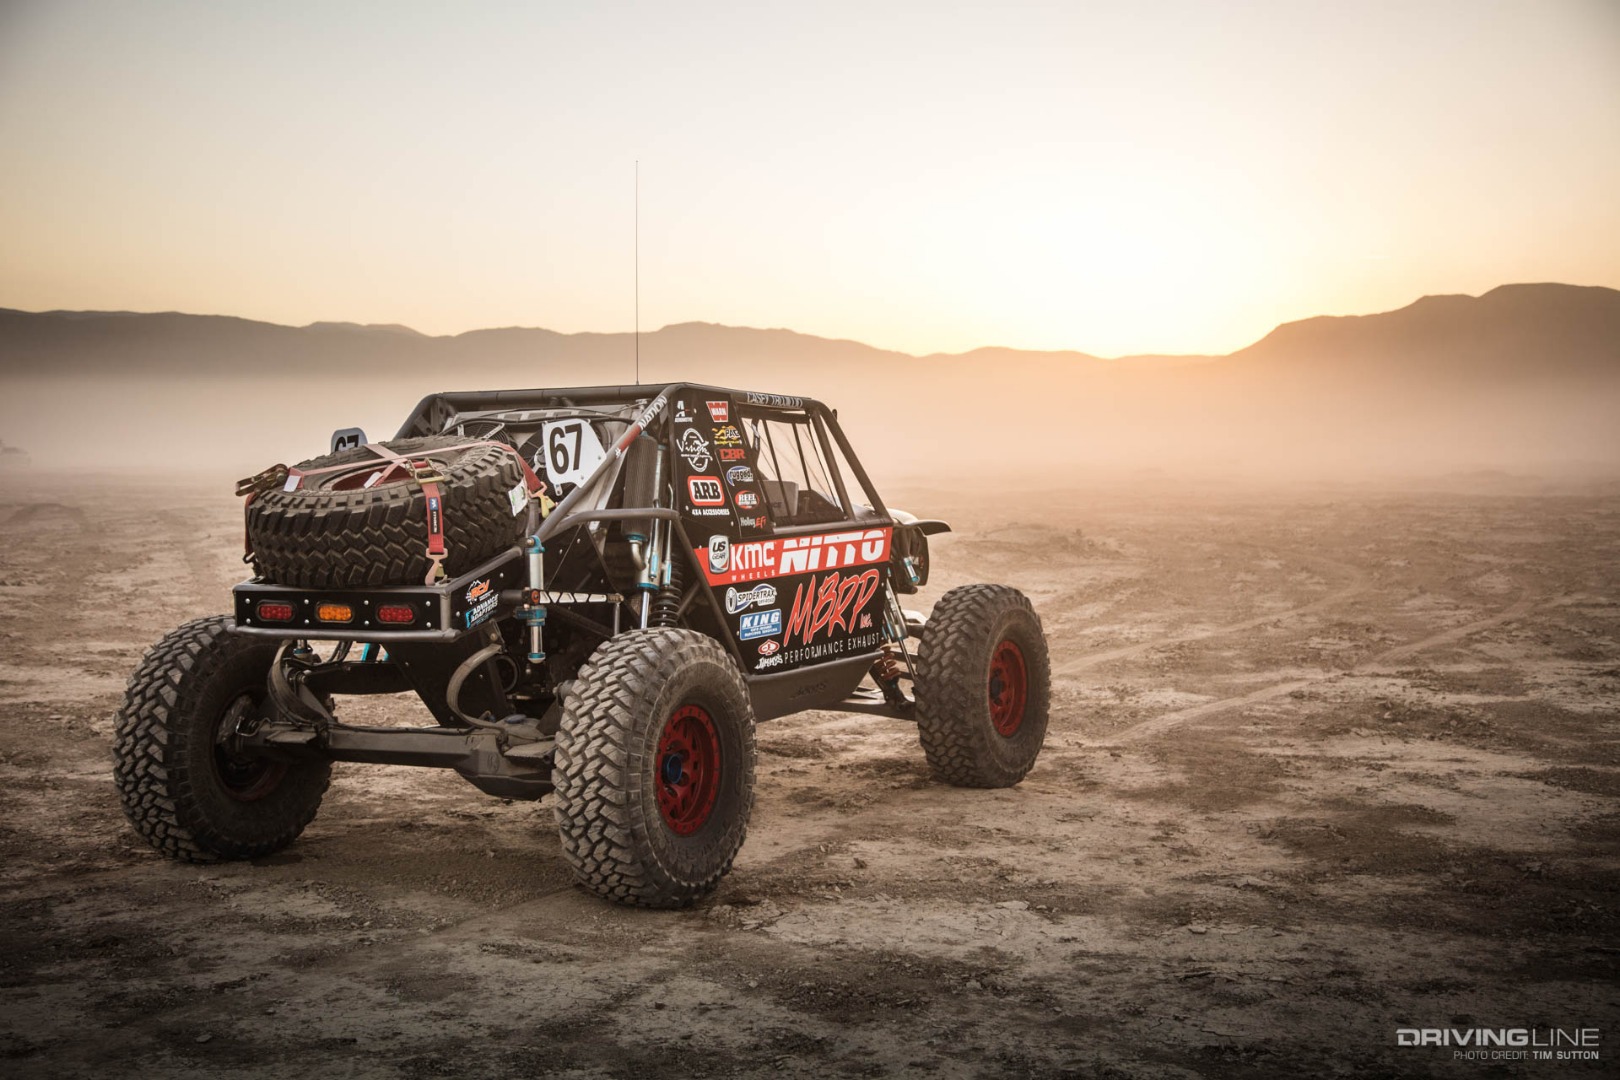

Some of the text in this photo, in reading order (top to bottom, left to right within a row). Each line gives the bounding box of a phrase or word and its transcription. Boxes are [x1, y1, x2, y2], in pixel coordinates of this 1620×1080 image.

[549, 423, 582, 475] 67
[692, 482, 721, 500] ARB
[712, 541, 726, 553] US
[779, 529, 885, 574] NITTO
[731, 569, 775, 582] WHEELS
[473, 594, 499, 615] ADVANCE
[738, 588, 776, 602] SPIDERTRAX
[470, 601, 498, 623] ADAPTERS
[783, 569, 880, 647] MBRP
[742, 612, 780, 629] KING
[784, 632, 880, 664] PERFORMANCE EXHAUST
